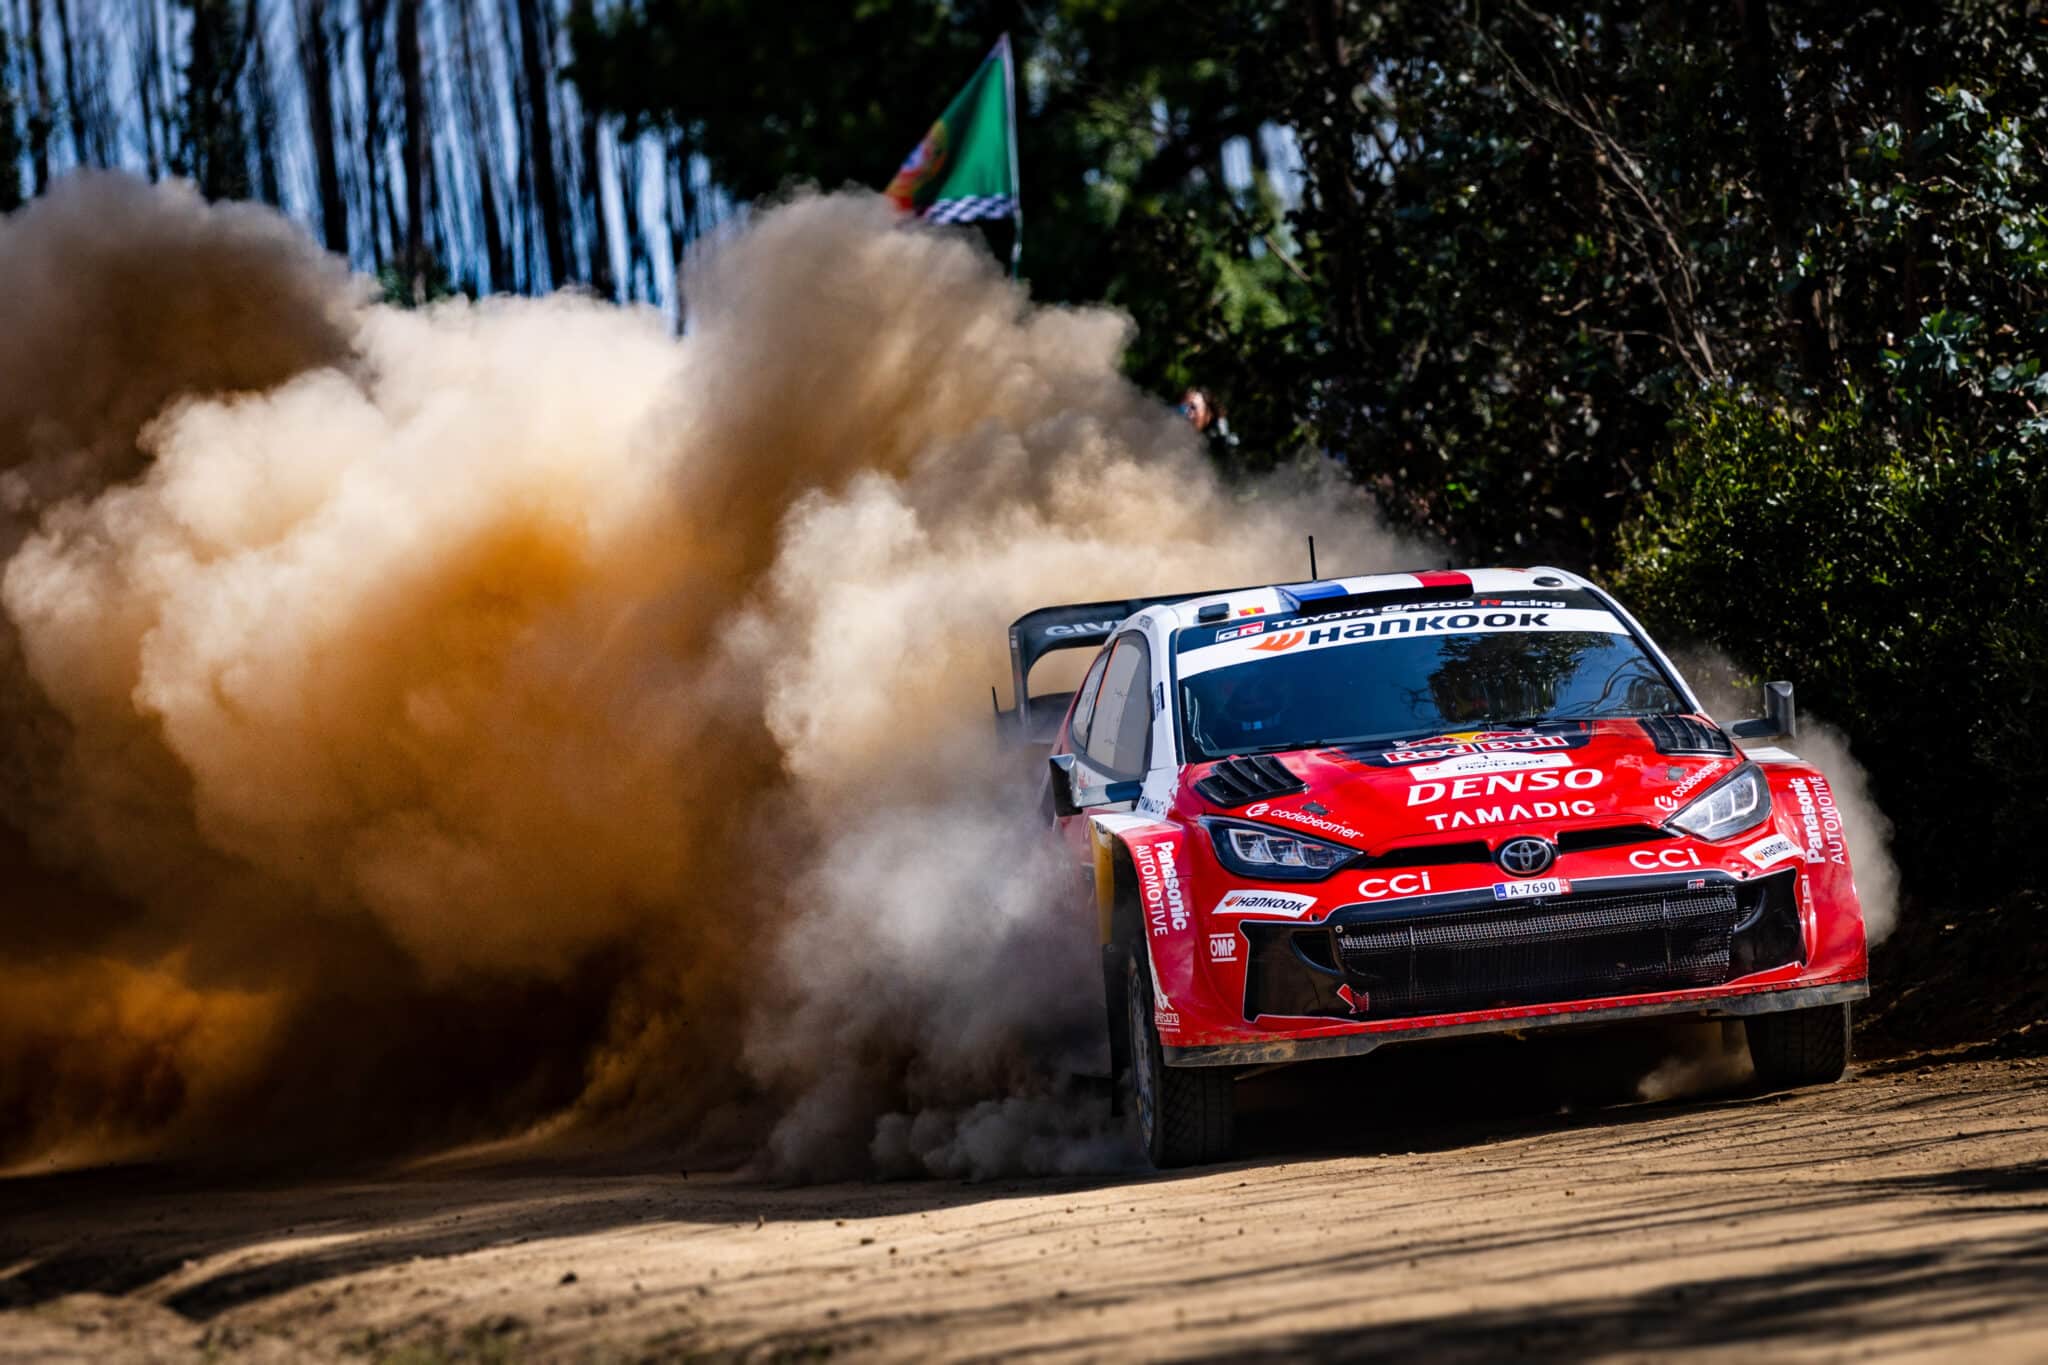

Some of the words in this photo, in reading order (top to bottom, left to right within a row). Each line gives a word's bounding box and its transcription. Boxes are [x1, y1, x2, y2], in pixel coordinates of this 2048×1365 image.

[1272, 607, 1374, 628] TOYOTA
[1382, 600, 1474, 612] GAZOO
[1479, 599, 1566, 609] Racing
[1217, 622, 1265, 642] GR
[1382, 744, 1478, 763] Red
[1478, 736, 1569, 752] Bull
[1407, 769, 1603, 807] DENSO
[1270, 808, 1360, 839] codebeamer
[1425, 800, 1596, 830] TAMADIC
[1788, 778, 1825, 864] Panasonic
[1808, 776, 1845, 865] AUTOMOTIVE
[1135, 845, 1168, 936] AUTOMOTIVE
[1154, 841, 1190, 930] Panasonic
[1510, 881, 1556, 896] A-7690
[1210, 939, 1236, 957] OMP
